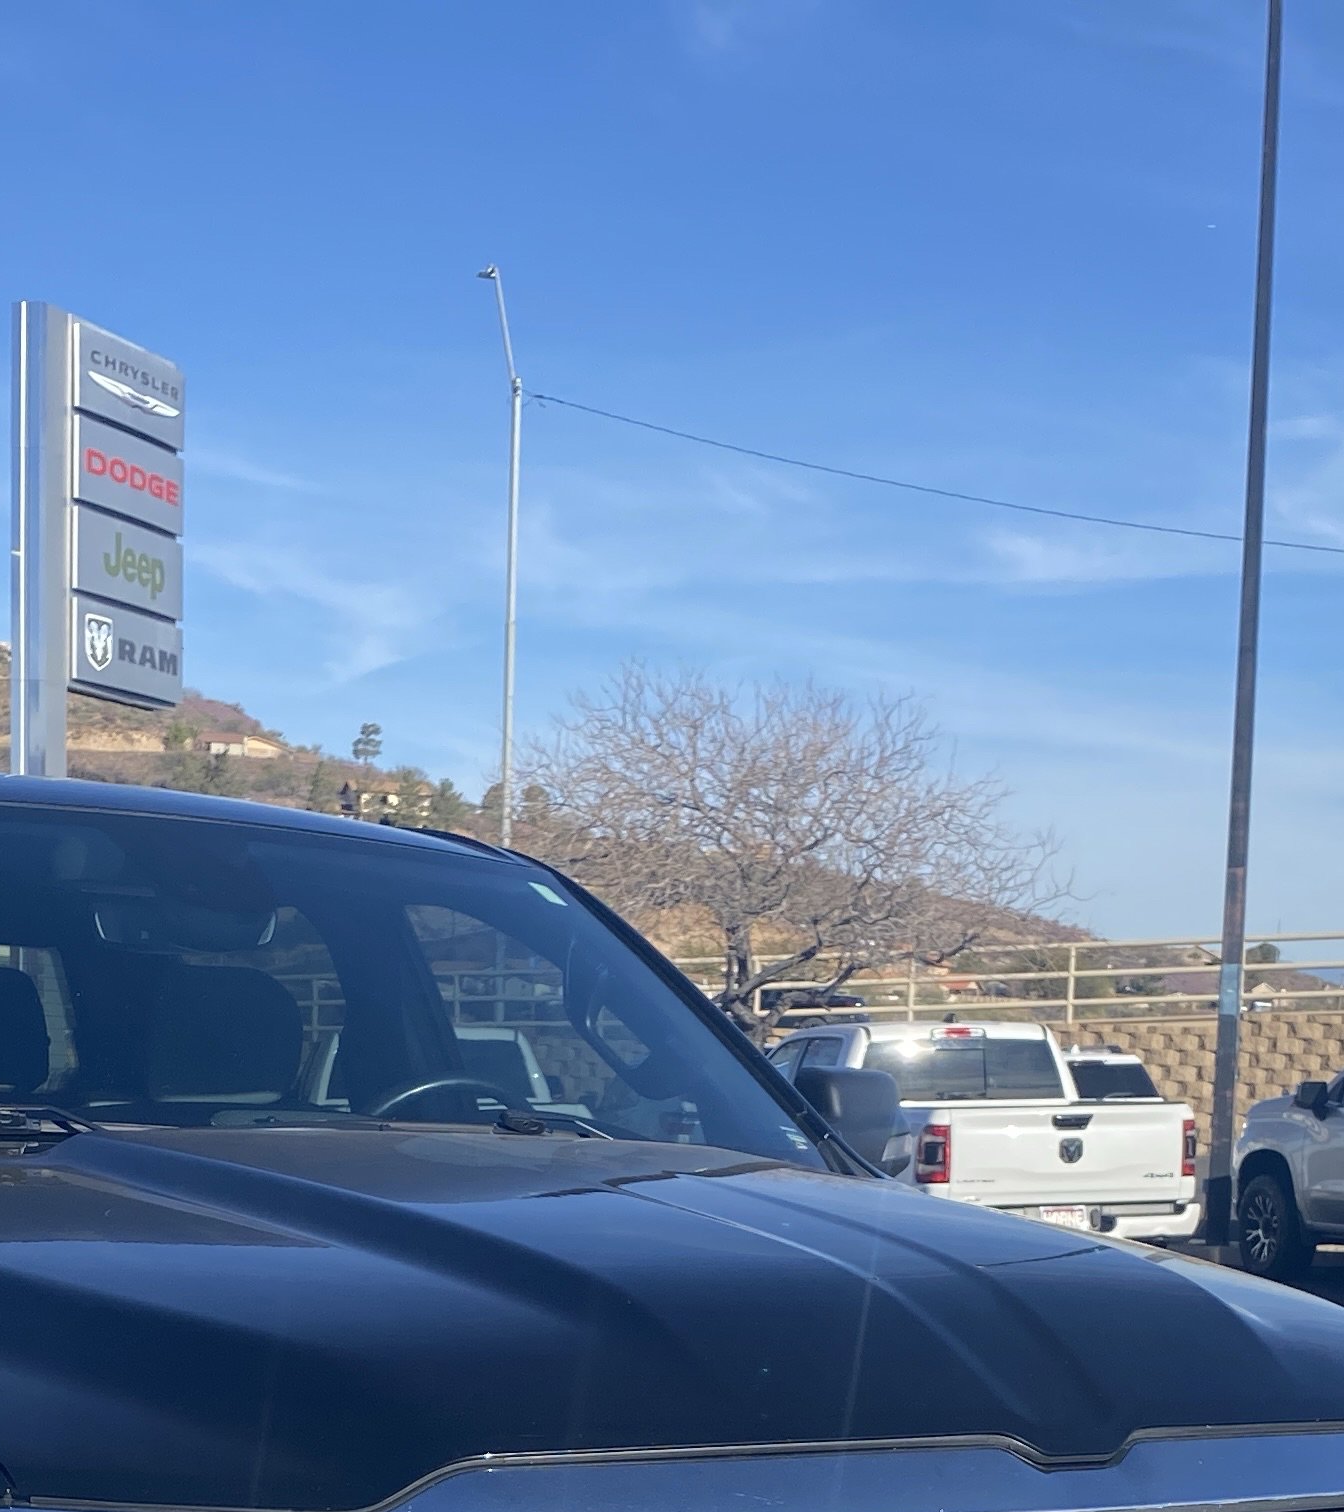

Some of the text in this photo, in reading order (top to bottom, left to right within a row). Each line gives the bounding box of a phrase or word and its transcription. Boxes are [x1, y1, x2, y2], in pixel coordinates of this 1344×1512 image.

[90, 350, 178, 401] CHRYSLER
[85, 448, 179, 506] DODGE
[103, 532, 165, 599] Jeep
[118, 638, 177, 676] RAM
